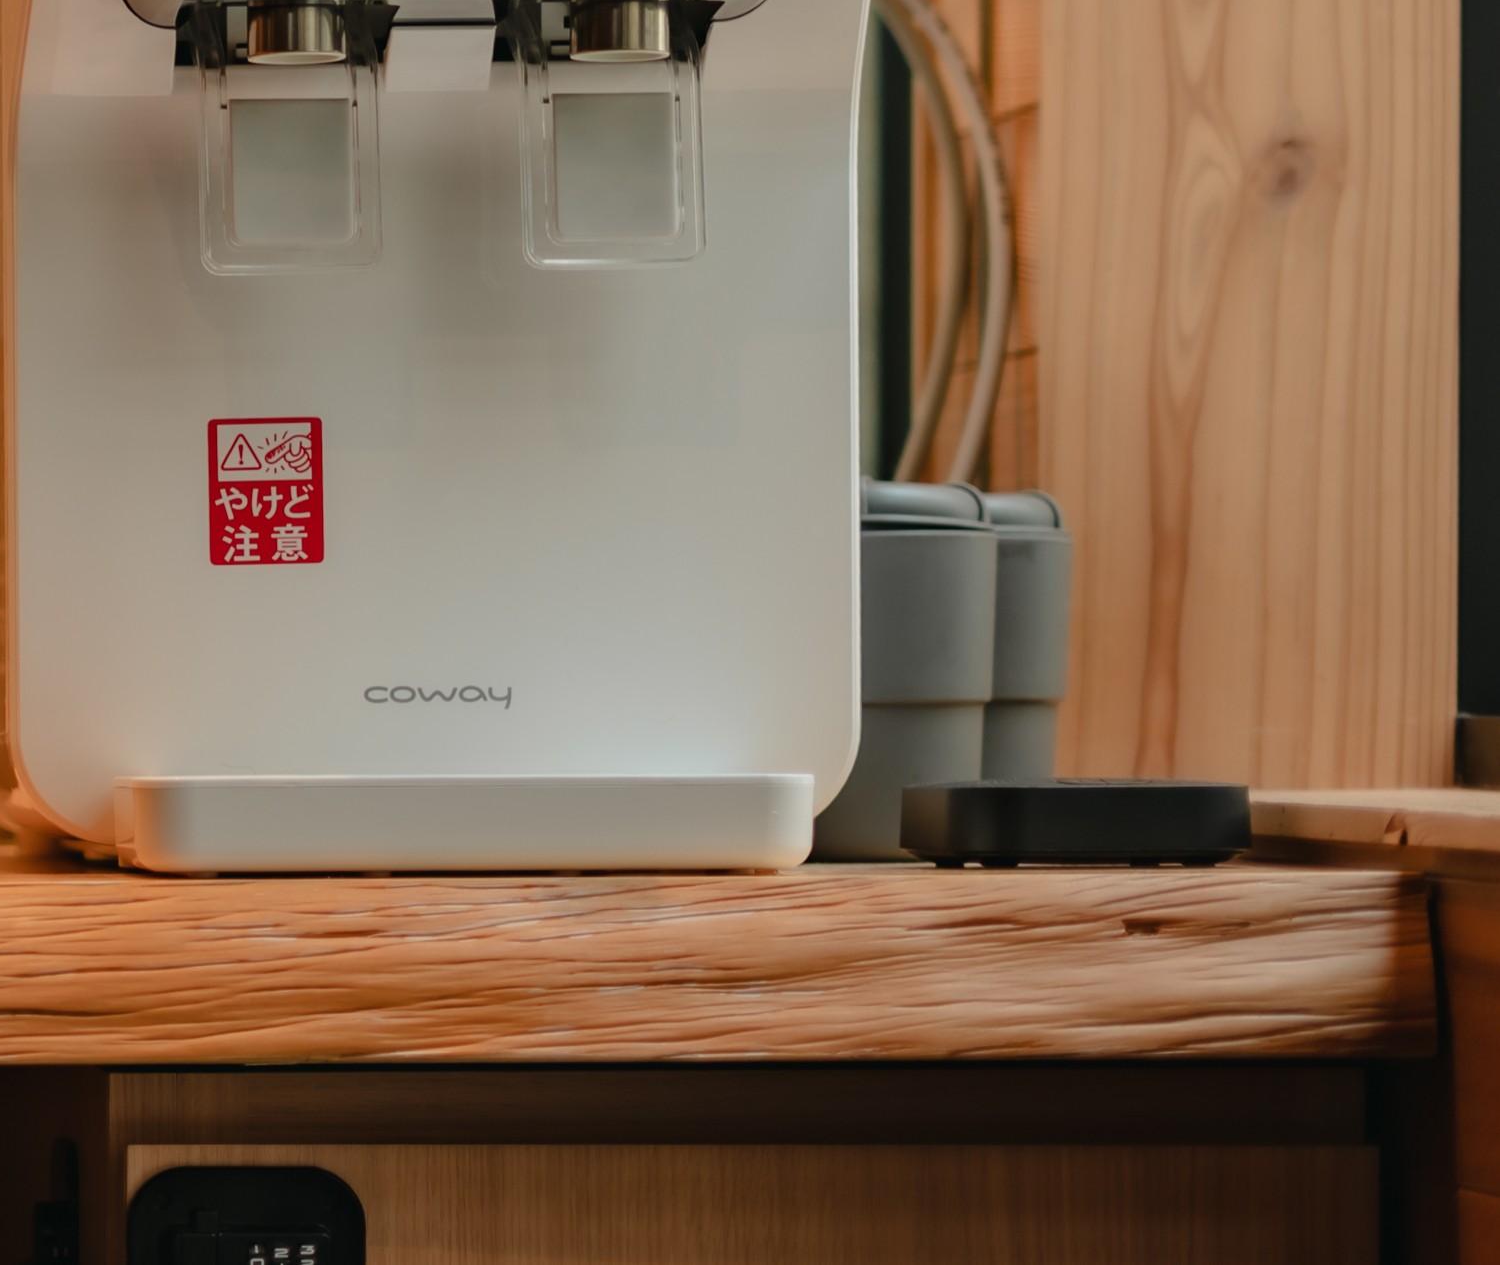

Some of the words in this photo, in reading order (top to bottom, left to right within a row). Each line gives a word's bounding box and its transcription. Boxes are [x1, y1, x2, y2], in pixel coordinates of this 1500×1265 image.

[214, 483, 315, 522] やけど
[221, 522, 310, 564] 注意
[363, 685, 513, 710] coway
